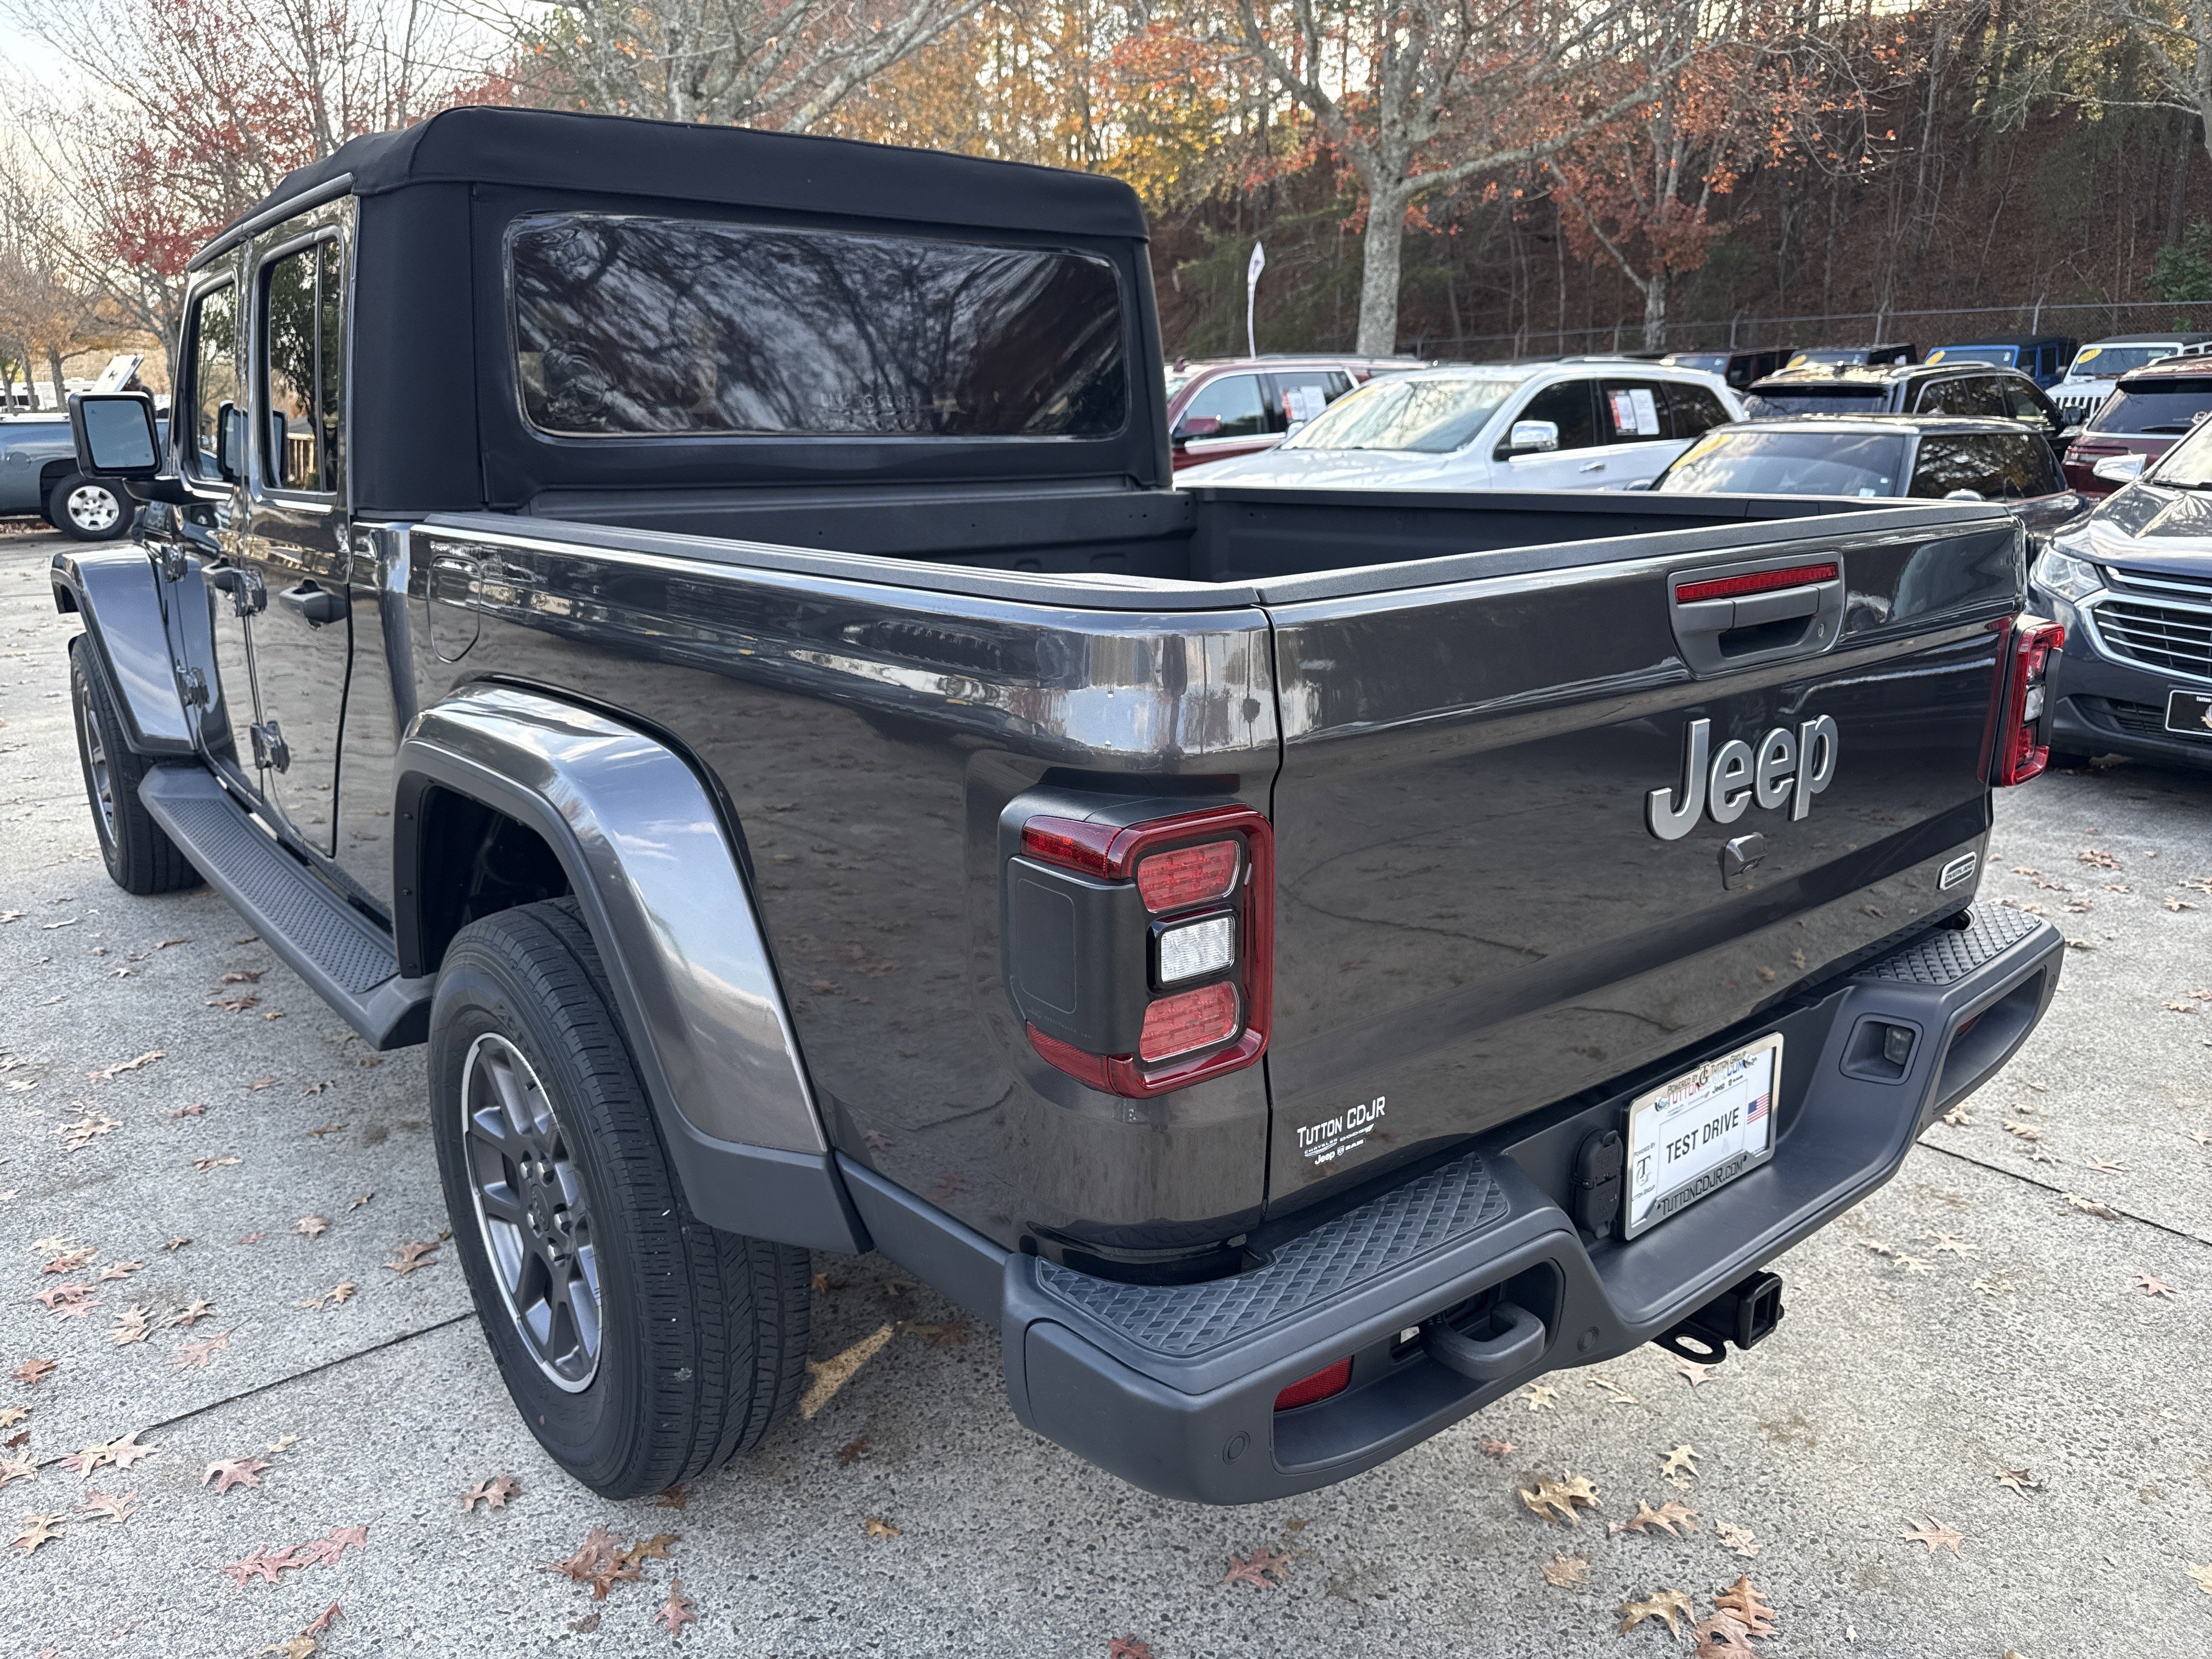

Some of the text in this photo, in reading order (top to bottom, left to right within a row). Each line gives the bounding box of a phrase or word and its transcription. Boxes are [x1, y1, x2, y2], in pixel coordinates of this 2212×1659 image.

[1646, 714, 1838, 840] Jeep
[1945, 861, 1974, 882] OVERLAND
[1667, 1077, 1691, 1094] POWERED
[1692, 1073, 1699, 1083] BY
[1711, 1060, 1729, 1073] TUTTON
[1712, 1083, 1725, 1094] Jeep
[1297, 1096, 1385, 1148] TUTTON CDJR
[1666, 1107, 1739, 1164] TEST DRIVE
[1305, 1138, 1338, 1154] CHRYSLER
[1314, 1139, 1364, 1165] Jeep RAM
[1661, 1159, 1742, 1215] TUTTONCDJR.COM
